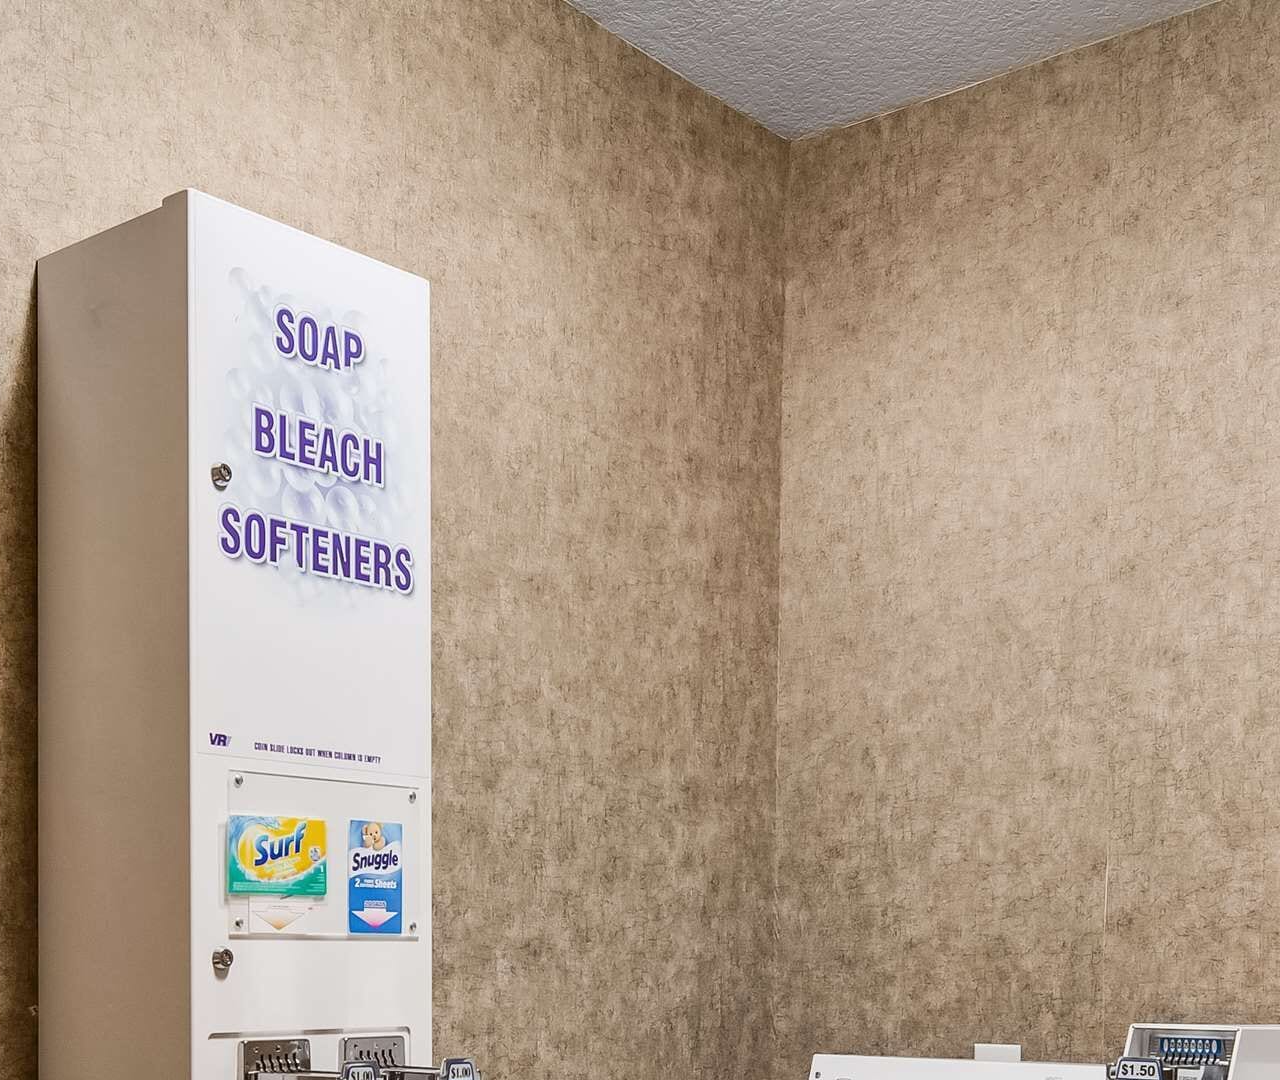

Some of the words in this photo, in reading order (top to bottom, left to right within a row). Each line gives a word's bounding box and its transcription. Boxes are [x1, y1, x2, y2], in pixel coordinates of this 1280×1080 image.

[275, 307, 364, 371] SOAP
[254, 406, 383, 485] BLEACH
[220, 506, 413, 592] SOFTENERS
[254, 742, 268, 751] COIN
[270, 743, 285, 754] SLIDE
[287, 745, 303, 755] LOCKS
[305, 748, 316, 757] OUT
[334, 751, 356, 761] COLUMN
[365, 755, 381, 764] EMPTY
[254, 822, 307, 866] Surf
[352, 850, 399, 871] Snuggle
[354, 878, 360, 887] 2
[374, 879, 397, 889] Sheets
[450, 1066, 470, 1080] $1.00
[1121, 1064, 1156, 1077] $1.50
